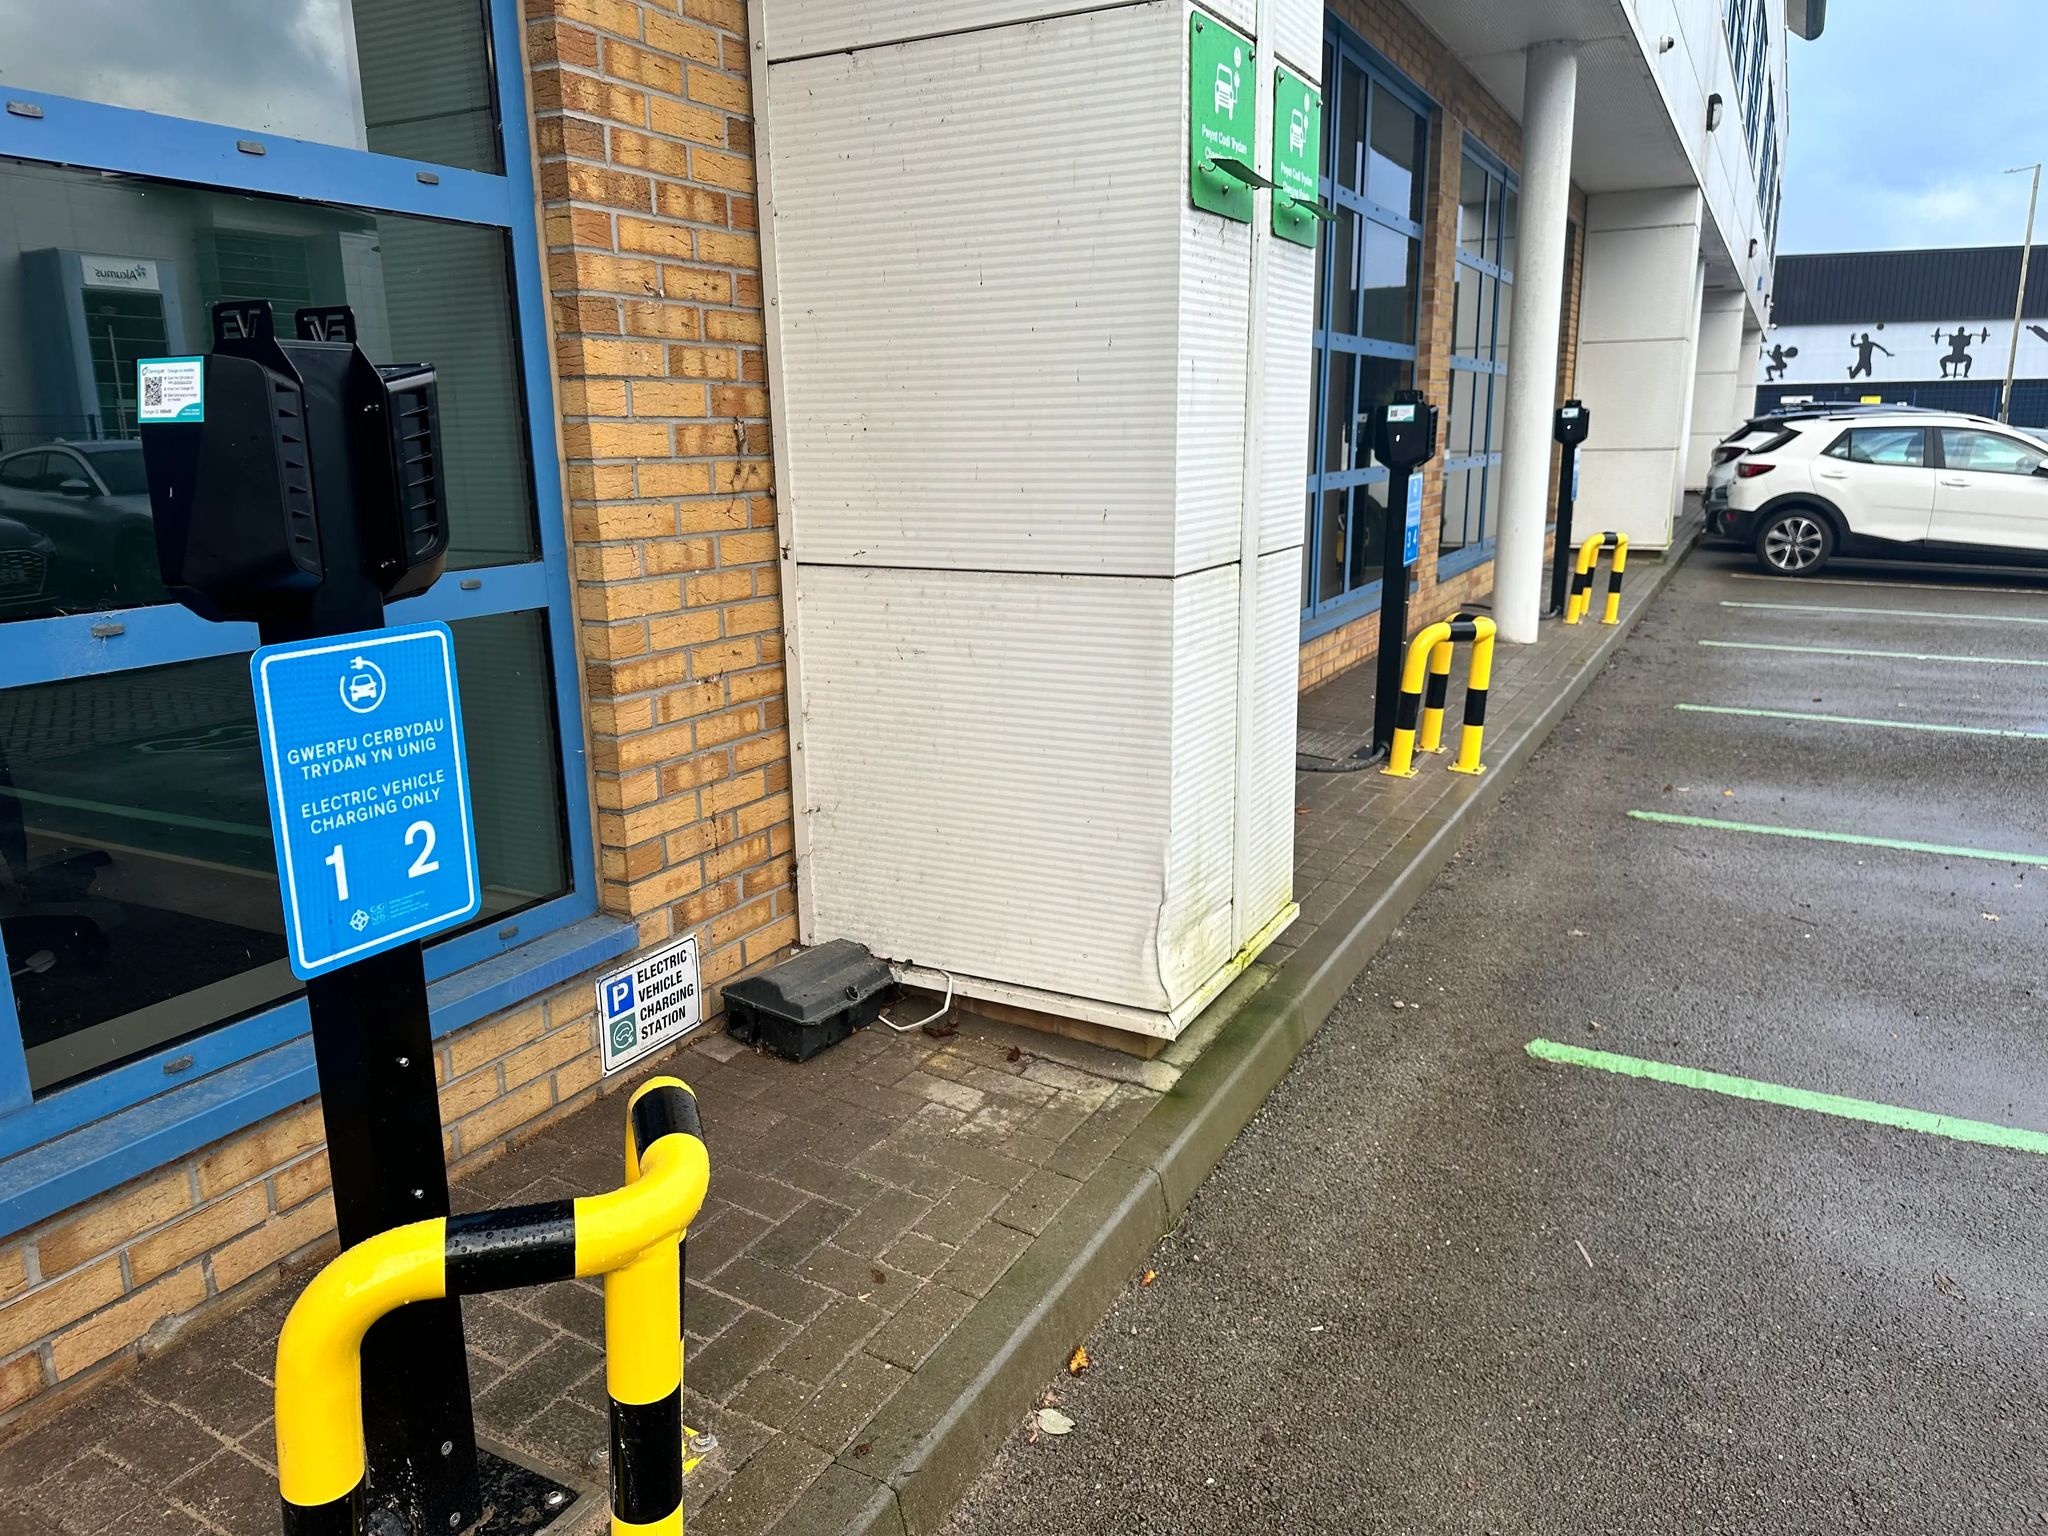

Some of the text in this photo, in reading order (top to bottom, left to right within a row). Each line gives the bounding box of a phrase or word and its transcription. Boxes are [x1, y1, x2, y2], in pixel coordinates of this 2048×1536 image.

[287, 717, 444, 766] GWERFU CERBYDAU
[300, 737, 437, 781] TRYDAN YN UNIG
[301, 769, 445, 819] ELECTRIC VEHICLE
[310, 787, 441, 835] CHARGING ONLY
[325, 820, 440, 902] 1 2
[637, 949, 687, 984] ELECTRIC
[638, 970, 683, 1003] VEHICLE
[612, 982, 629, 1012] P
[640, 983, 694, 1022] CHARGING
[641, 1005, 686, 1040] STATION
